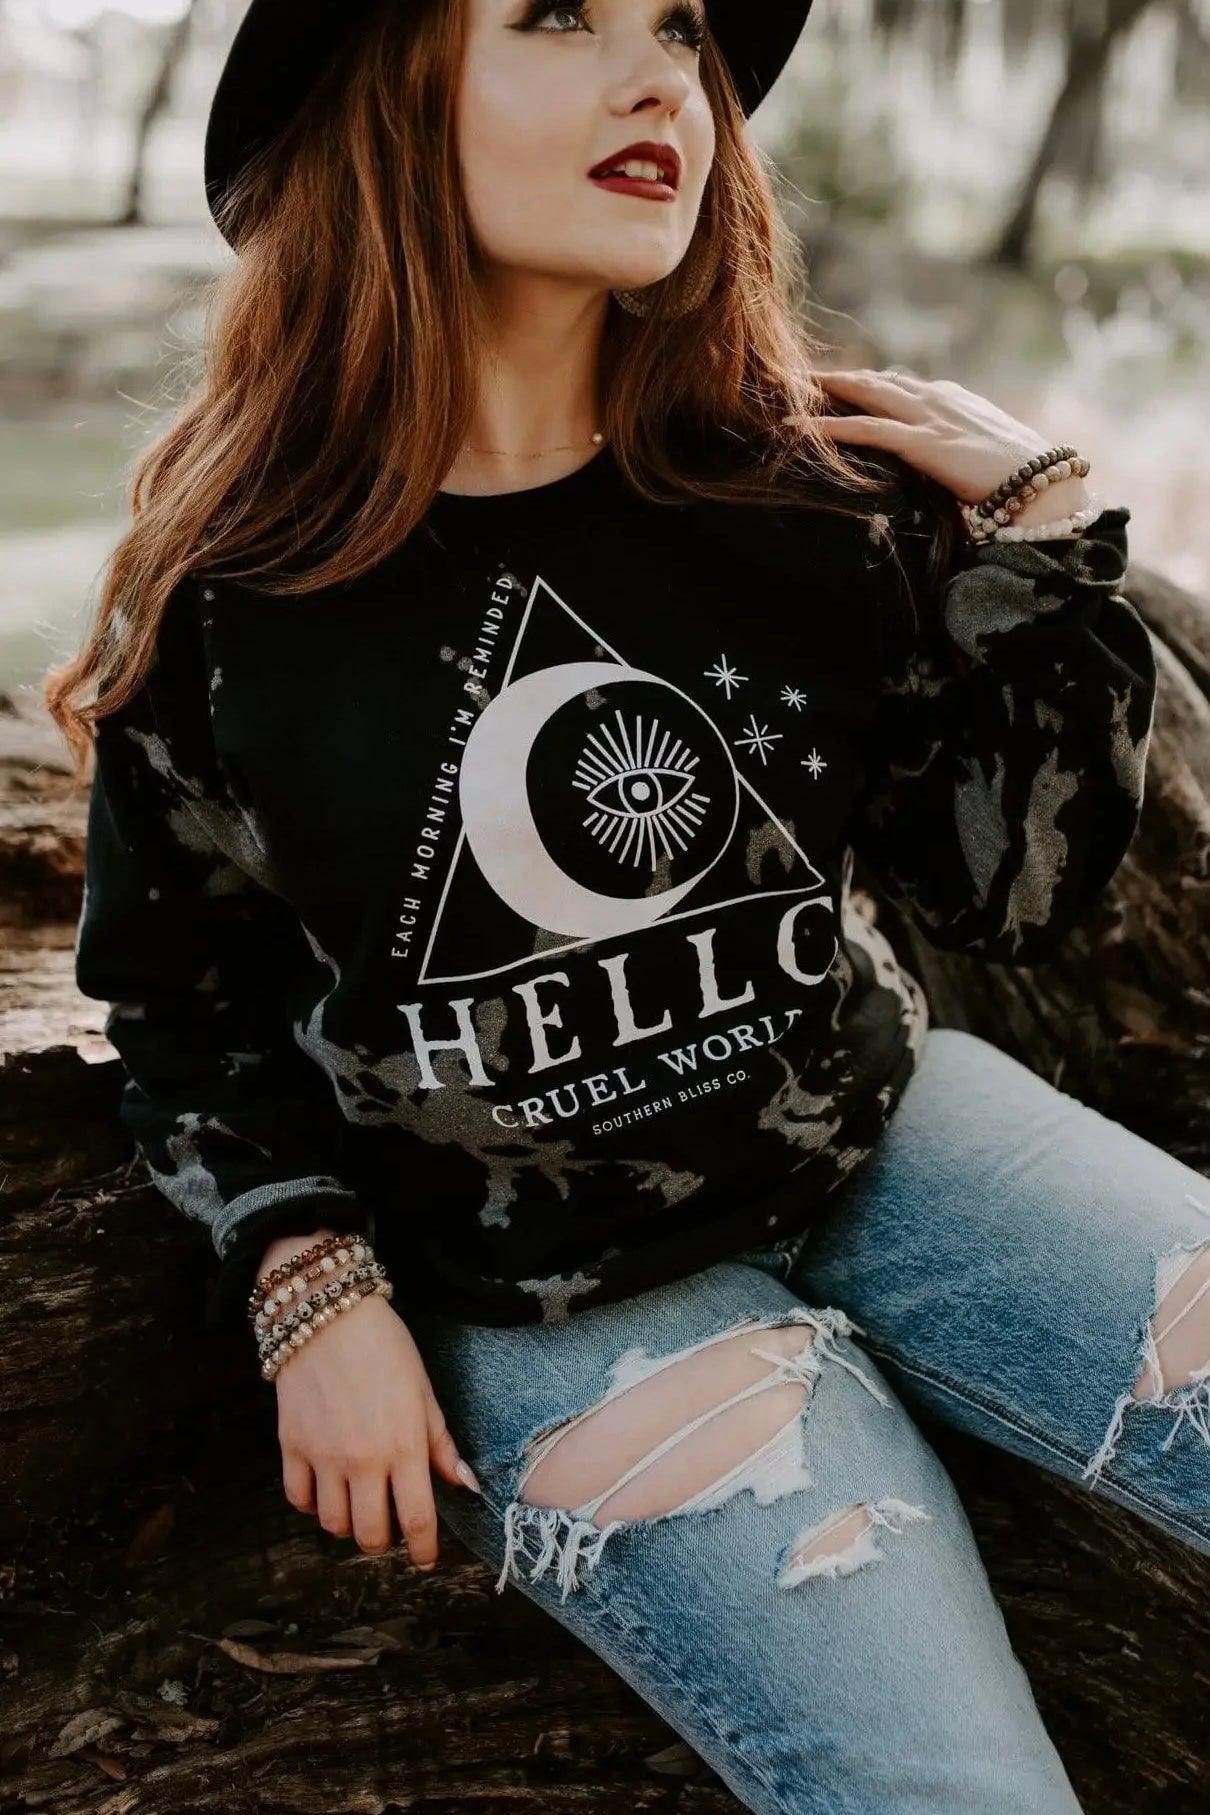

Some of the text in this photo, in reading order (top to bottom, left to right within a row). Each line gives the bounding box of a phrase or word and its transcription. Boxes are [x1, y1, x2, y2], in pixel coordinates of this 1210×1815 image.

[391, 575, 514, 958] EACH MORNING I'M REMINDED
[491, 1067, 647, 1130] CRUEL
[592, 1071, 752, 1136] SOUTHERN BLISS CO.
